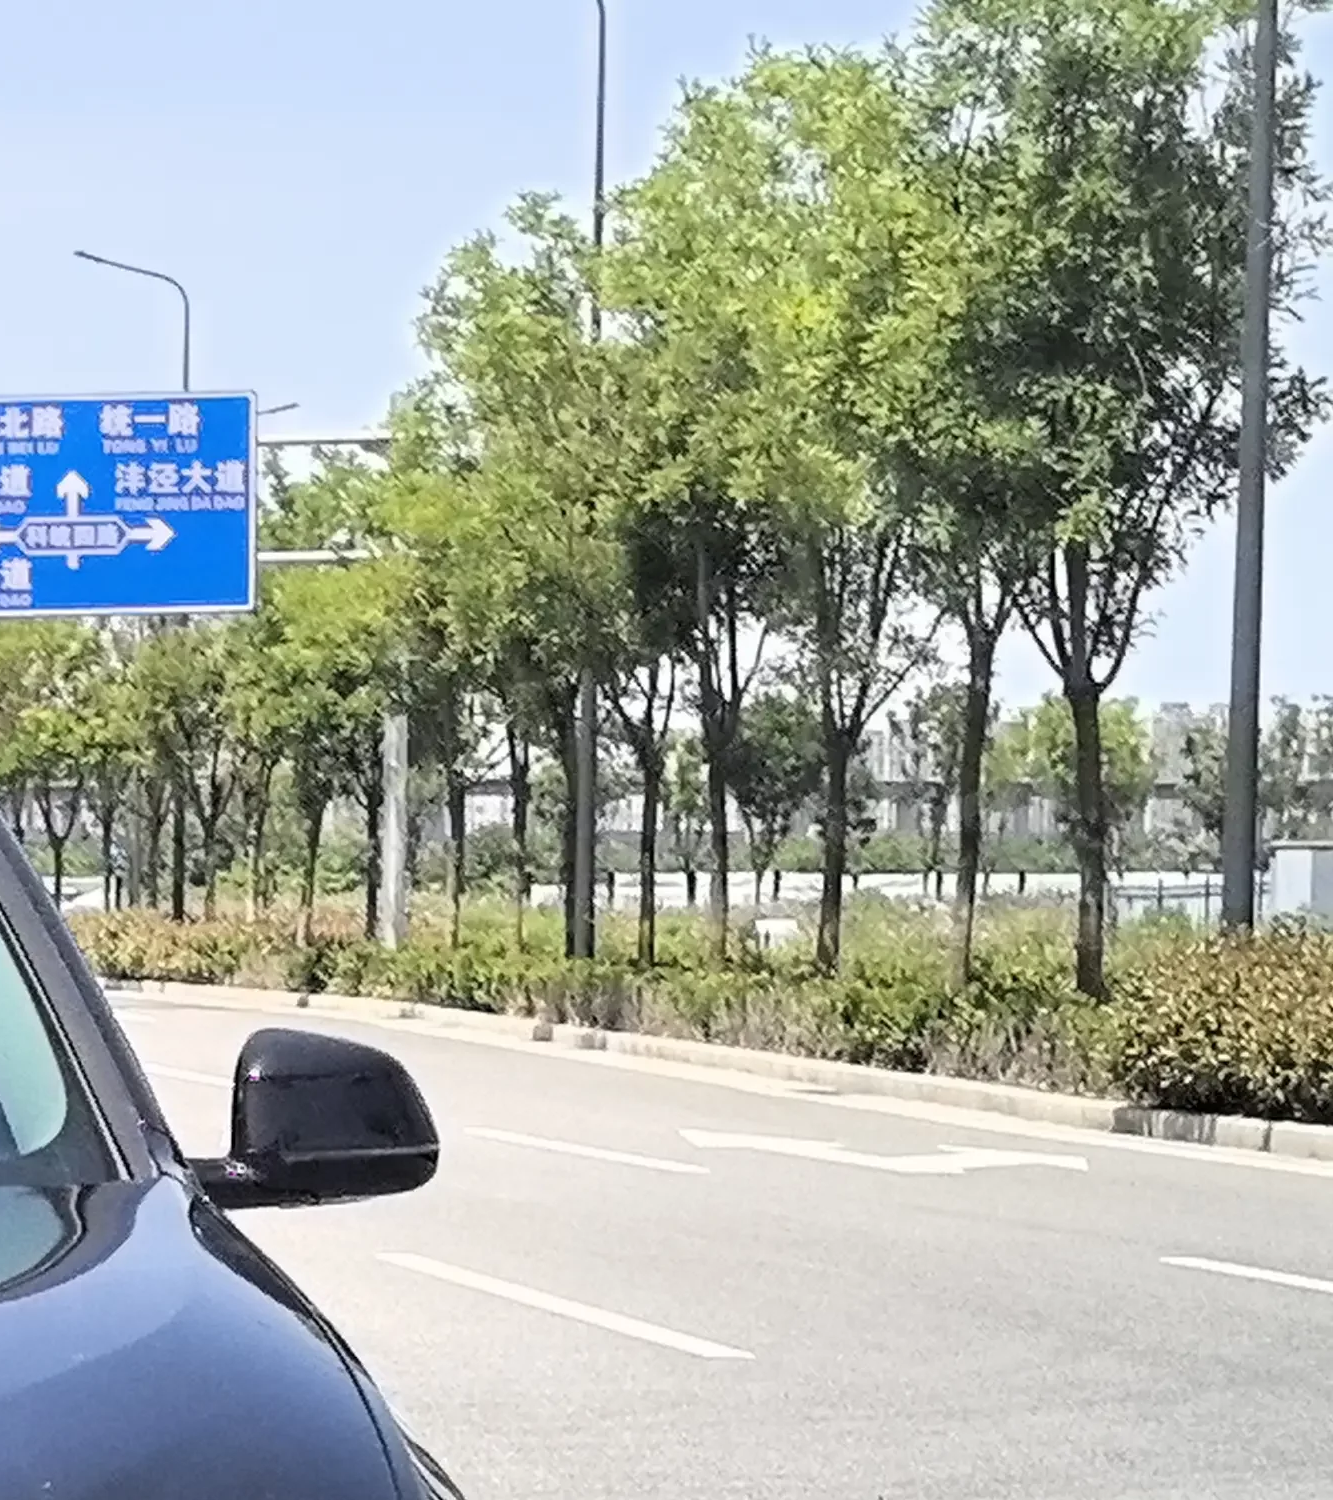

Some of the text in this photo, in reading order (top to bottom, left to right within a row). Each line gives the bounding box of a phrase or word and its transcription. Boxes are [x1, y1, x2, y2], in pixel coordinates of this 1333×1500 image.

[99, 402, 200, 437] 统一路
[36, 440, 60, 455] LU
[102, 437, 199, 454] TONG YI LU
[190, 496, 212, 511] DA
[213, 495, 245, 511] DAO
